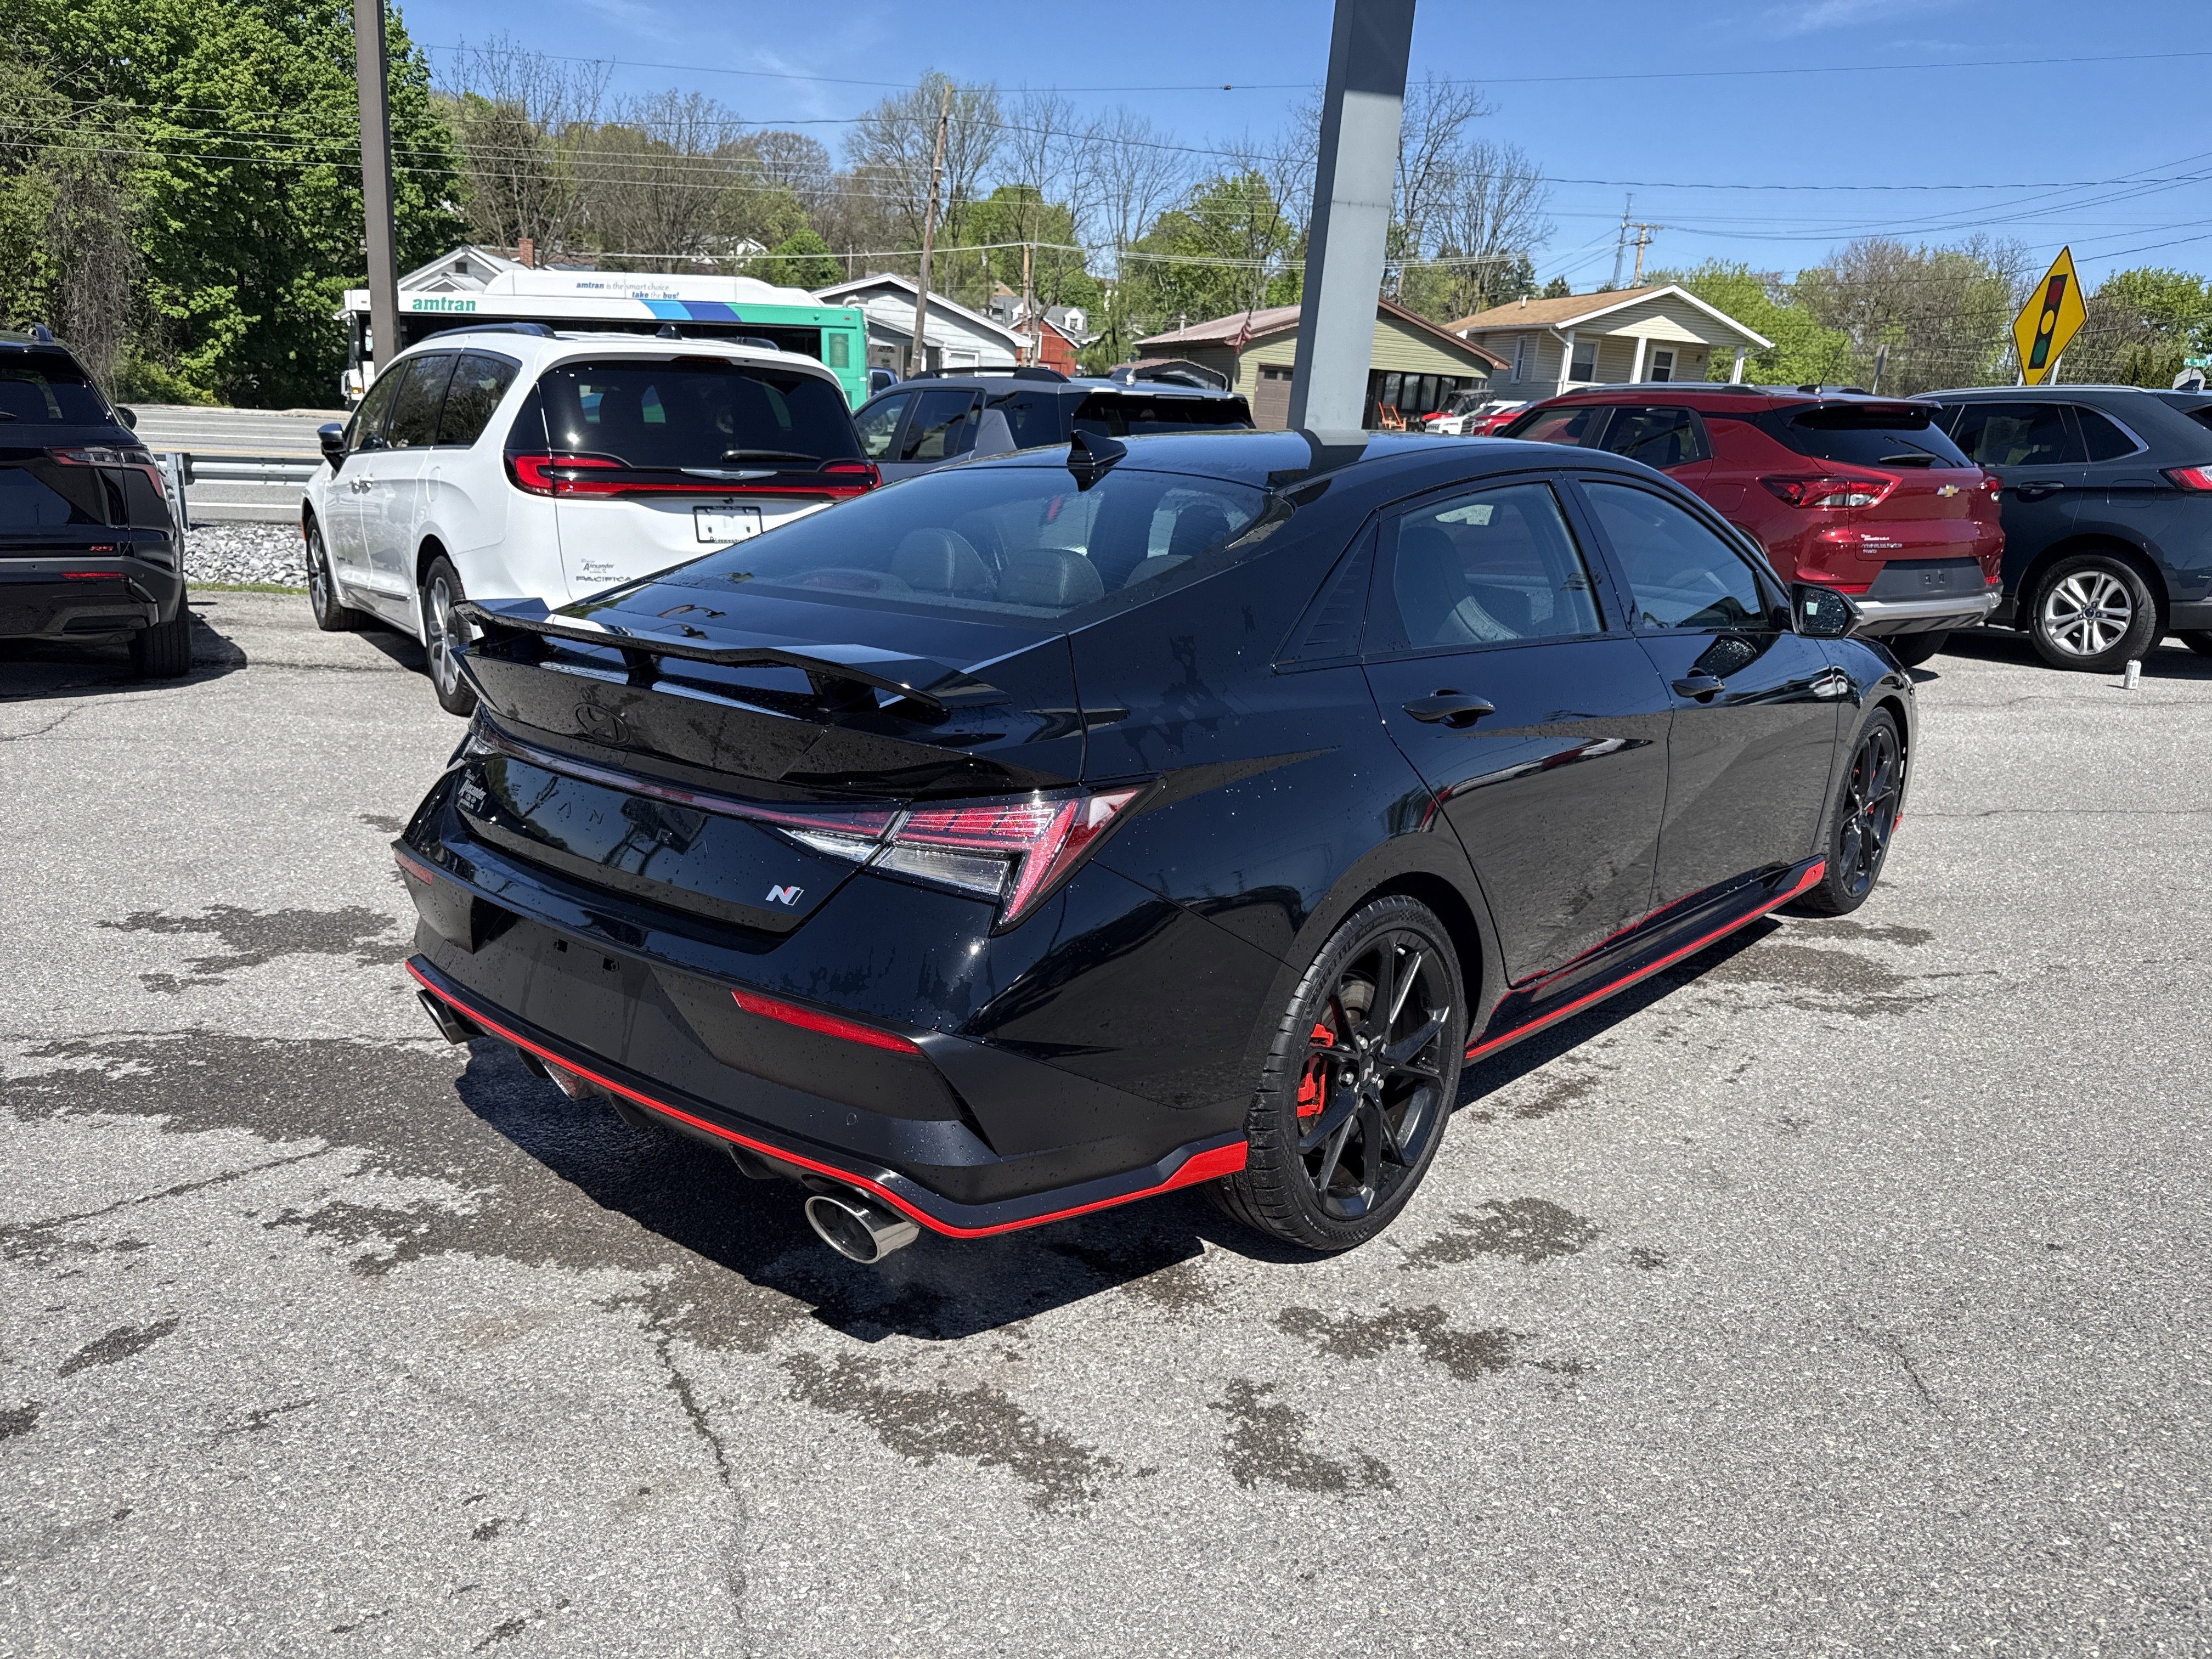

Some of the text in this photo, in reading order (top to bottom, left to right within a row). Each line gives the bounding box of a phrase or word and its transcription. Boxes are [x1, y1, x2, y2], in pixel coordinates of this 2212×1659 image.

[413, 297, 476, 311] amtran
[458, 778, 487, 801] Alexander
[765, 884, 804, 906] N
